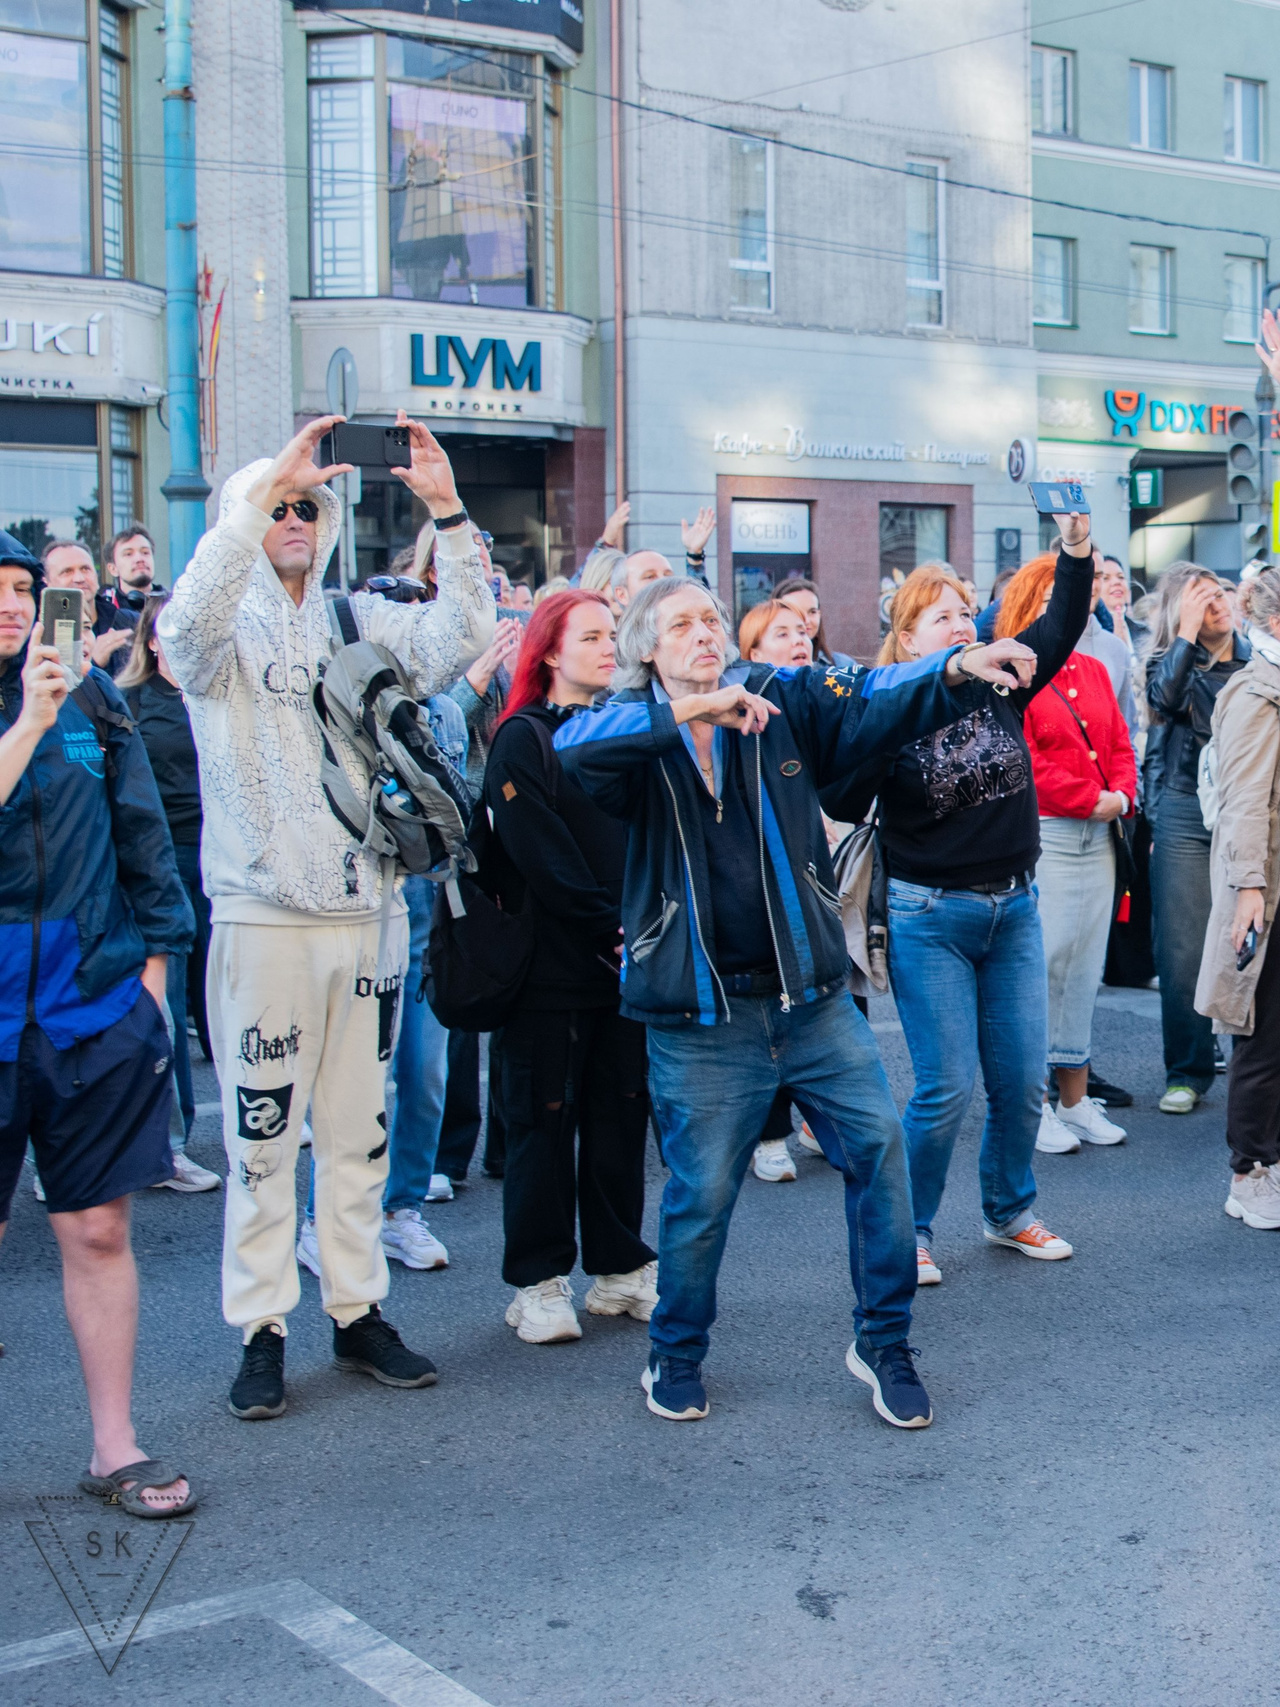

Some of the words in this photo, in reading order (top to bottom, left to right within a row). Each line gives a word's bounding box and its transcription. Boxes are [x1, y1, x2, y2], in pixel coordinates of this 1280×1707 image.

[410, 333, 541, 392] ЦУМ
[430, 400, 522, 413] ВОРОНЕЖ
[1150, 400, 1207, 434] DDX
[714, 431, 763, 460] Кафе
[738, 523, 798, 540] ОСЕНЬ
